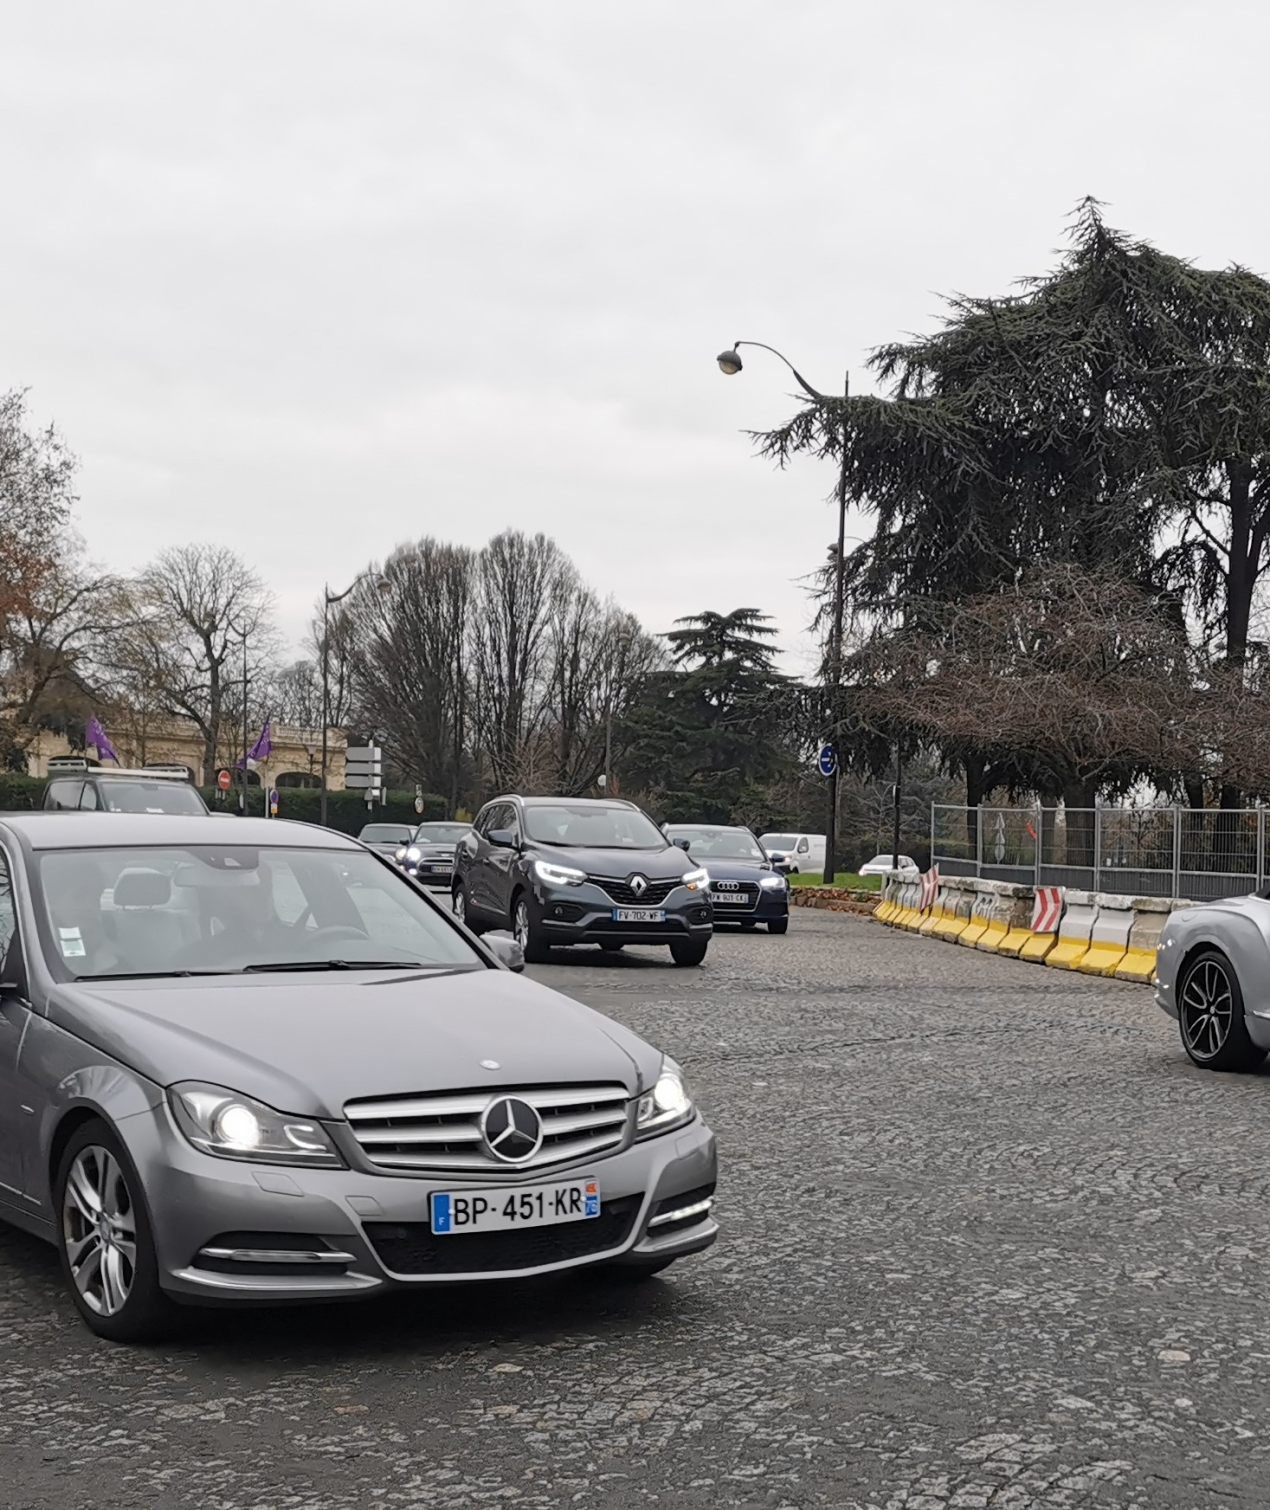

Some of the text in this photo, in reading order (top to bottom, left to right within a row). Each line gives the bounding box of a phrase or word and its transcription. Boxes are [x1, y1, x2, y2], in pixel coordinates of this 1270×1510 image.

[618, 910, 659, 920] FV-702-WF
[454, 1188, 582, 1226] BP-451-KR
[438, 1216, 445, 1226] F
